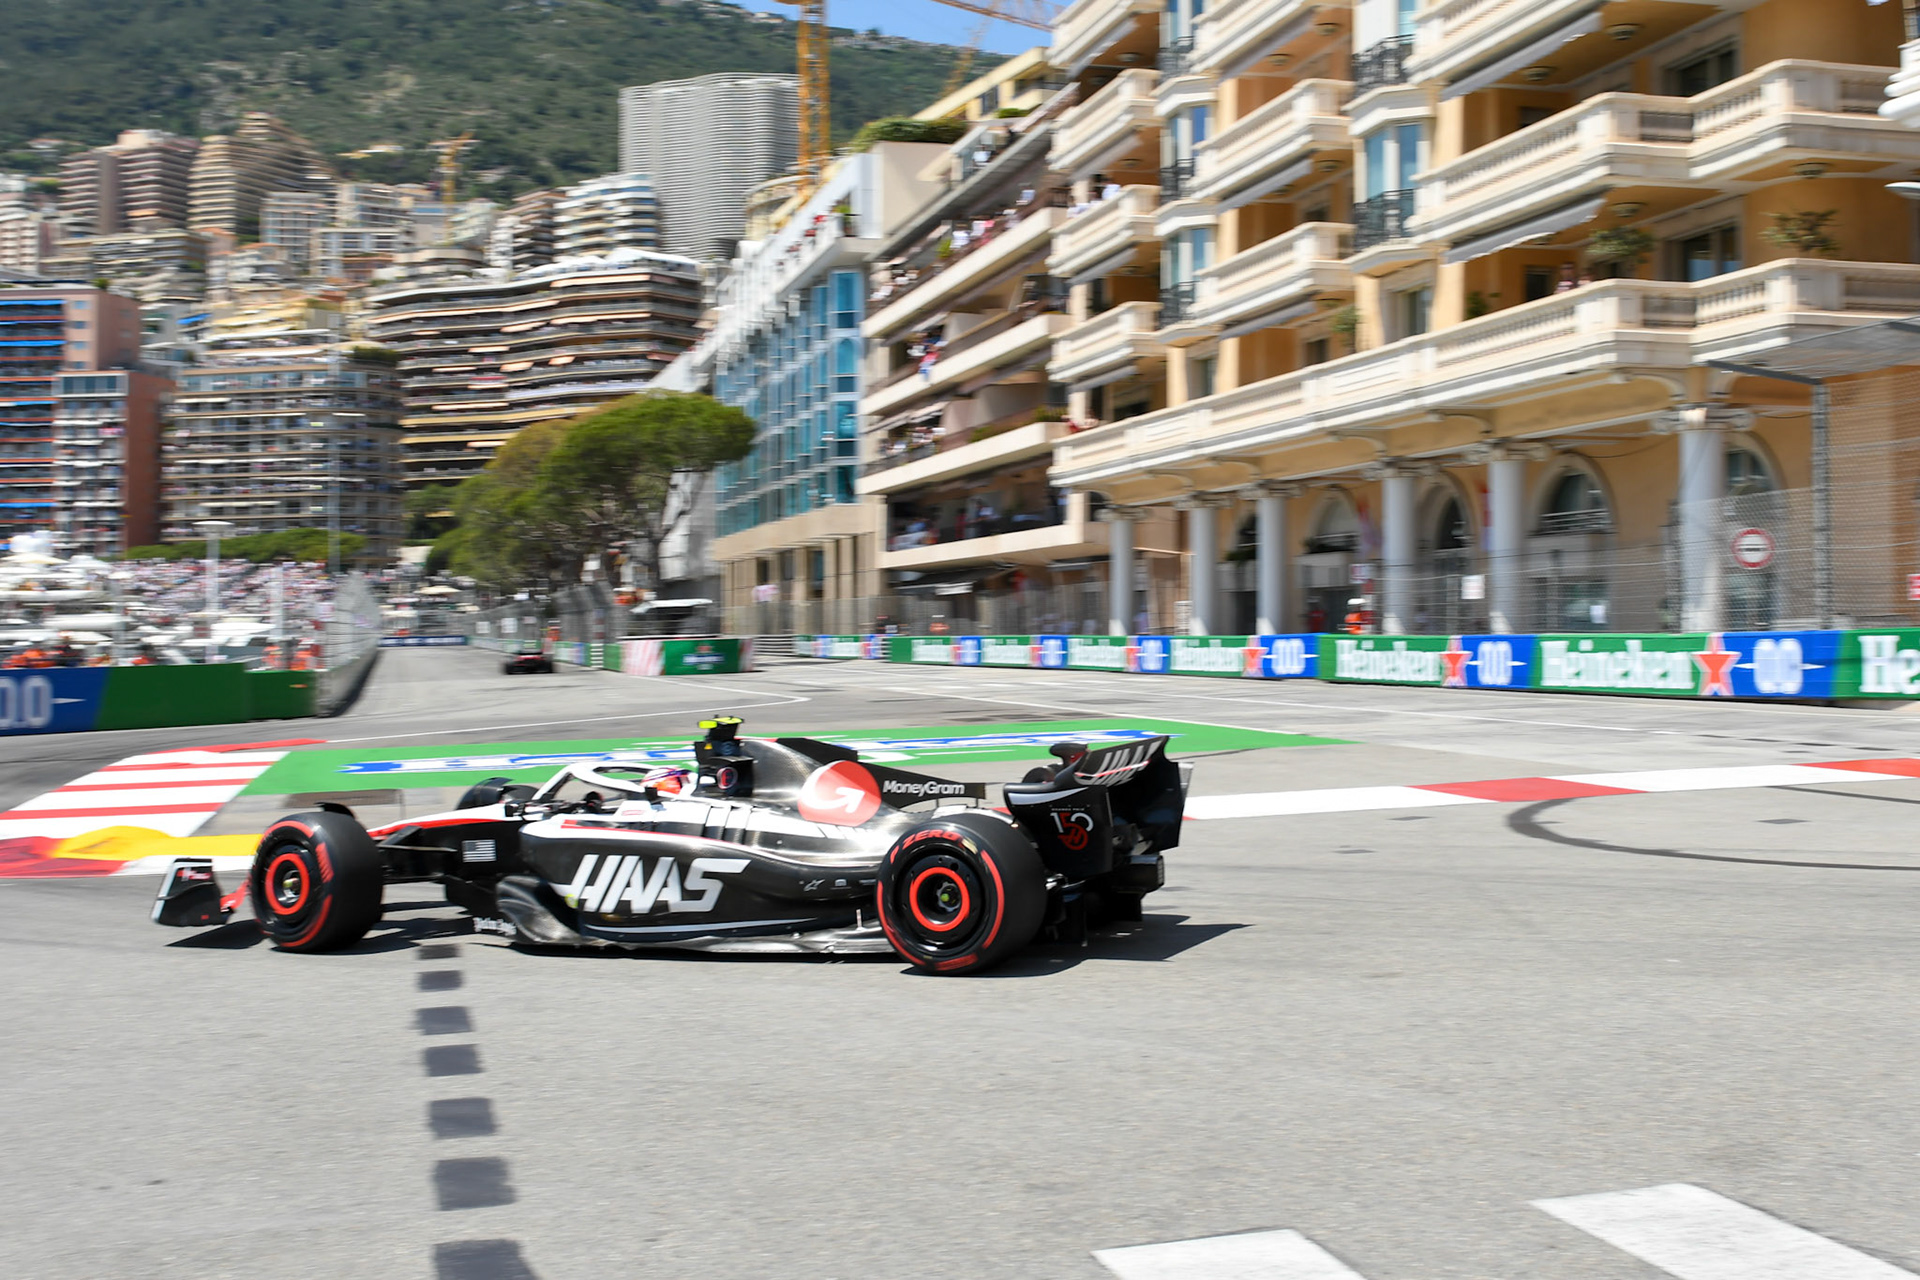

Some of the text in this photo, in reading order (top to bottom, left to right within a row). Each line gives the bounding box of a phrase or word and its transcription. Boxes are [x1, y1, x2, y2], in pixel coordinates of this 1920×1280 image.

[1541, 639, 1695, 689] Heineken
[882, 781, 965, 797] MoneyGram
[902, 829, 963, 850] ZERO
[549, 854, 751, 914] HAAS
